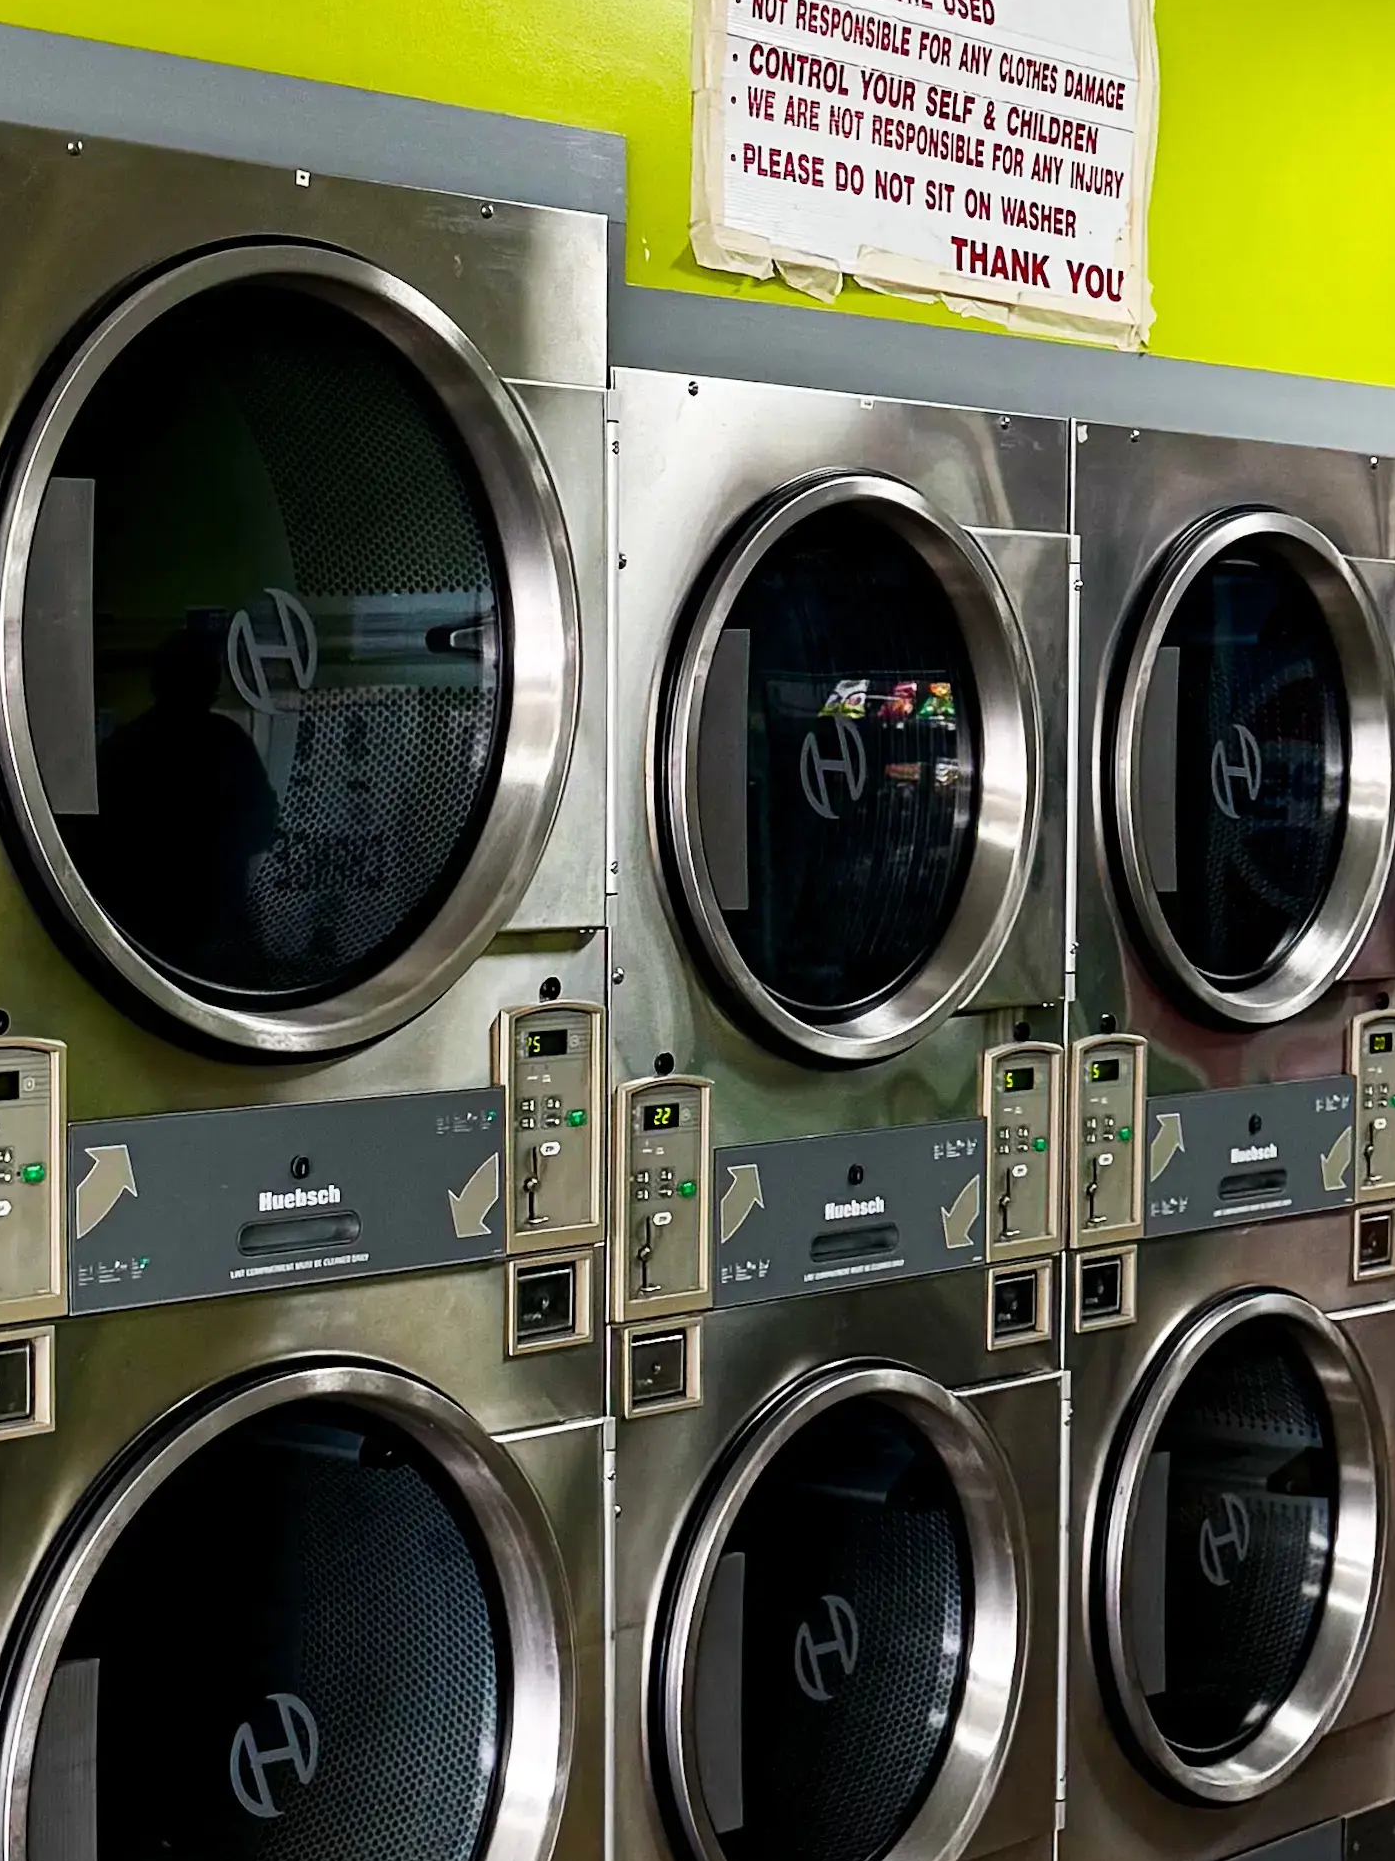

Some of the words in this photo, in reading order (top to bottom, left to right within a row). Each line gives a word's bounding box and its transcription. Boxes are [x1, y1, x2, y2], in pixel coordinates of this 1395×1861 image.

[749, 43, 848, 96] CONTROL
[860, 69, 916, 112] YOUR
[925, 86, 975, 124] SELF
[984, 100, 996, 131] &
[1007, 106, 1099, 155] CHILDREN
[919, 31, 952, 67] FOR
[959, 42, 993, 77] ANY
[1000, 52, 1057, 95] CLOTHES
[1064, 69, 1126, 111] DAMAGE
[747, 86, 775, 121] WE
[784, 95, 820, 132] ARE
[829, 105, 864, 141] NOT
[872, 114, 985, 169] RESPONSIBLE
[992, 143, 1024, 178] FOR
[1031, 152, 1063, 186] ANY
[1070, 161, 1124, 200] INJURY
[743, 142, 824, 188] PLEASE
[835, 161, 864, 196] DO
[875, 169, 915, 208] NOT
[925, 180, 954, 214] SIT
[965, 188, 991, 221] ON
[1001, 196, 1077, 238] WASHER
[951, 236, 1051, 289] THANK
[1066, 259, 1124, 302] YOU
[654, 1107, 671, 1125] 22
[259, 1184, 341, 1212] Huebsch
